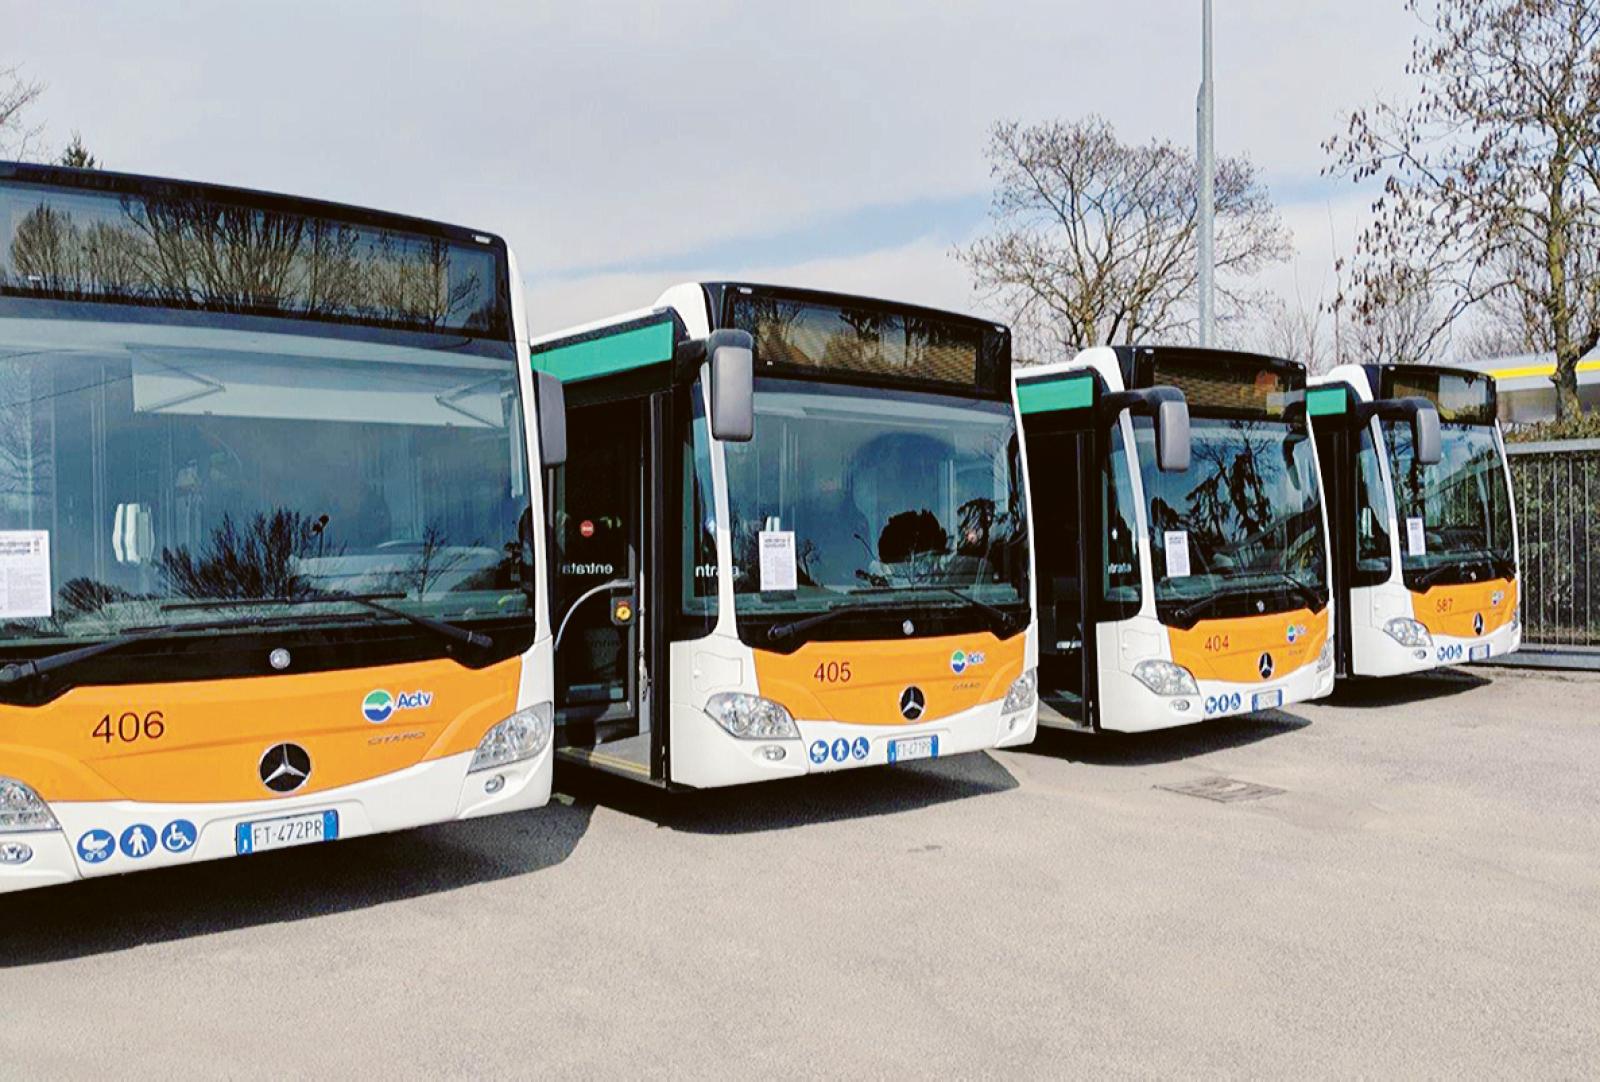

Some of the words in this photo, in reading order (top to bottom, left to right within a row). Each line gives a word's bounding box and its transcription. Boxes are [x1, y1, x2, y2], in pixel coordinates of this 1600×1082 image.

[1204, 635, 1229, 652] 404
[813, 661, 852, 682] 405
[397, 691, 432, 709] Actv
[92, 710, 164, 744] 406
